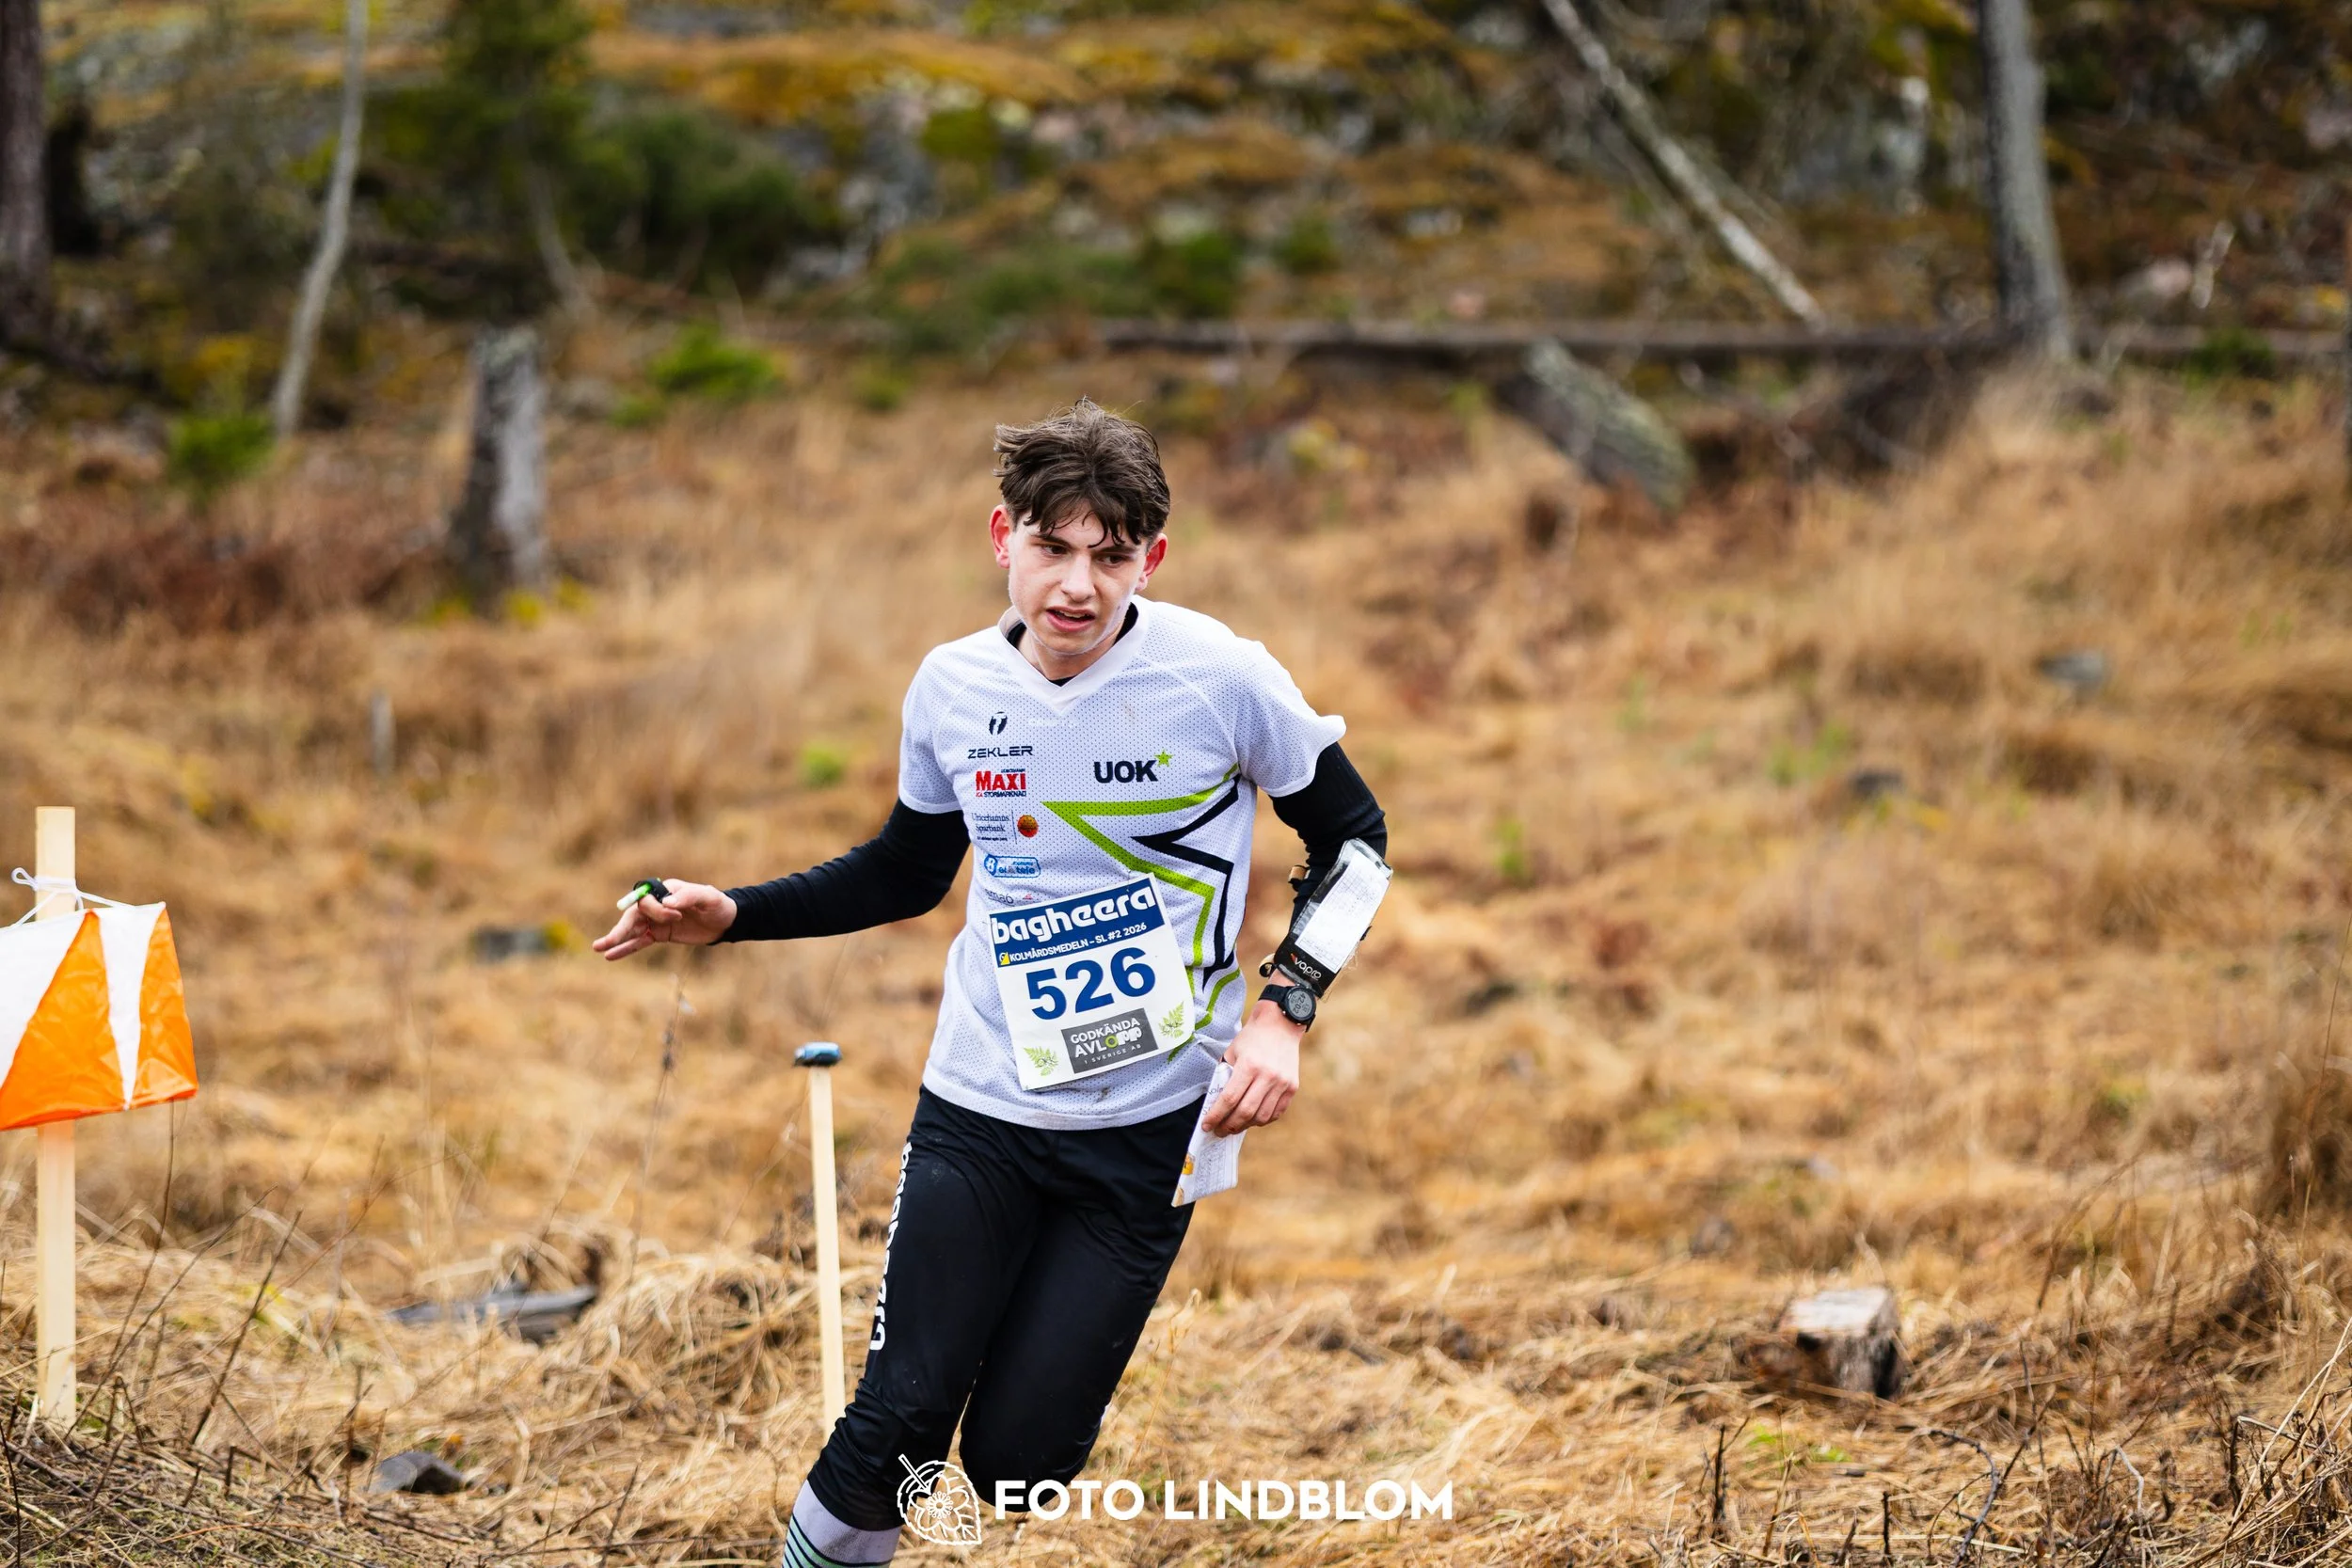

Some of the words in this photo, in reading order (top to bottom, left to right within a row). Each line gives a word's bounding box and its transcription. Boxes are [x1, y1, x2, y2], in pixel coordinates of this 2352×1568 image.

[967, 746, 1034, 759] ZEKLER
[976, 770, 1026, 791] MAXI
[1094, 760, 1158, 784] UOK
[991, 886, 1156, 944] bagheera
[1009, 939, 1089, 962] KOLMÅRDSMEDELN
[1095, 934, 1107, 944] SL
[1108, 929, 1122, 941] #2
[1122, 923, 1147, 937] 2026
[1295, 958, 1322, 979] vapro
[1026, 947, 1156, 1021] 526
[1070, 1018, 1141, 1044] GODKÄNDA
[1074, 1027, 1142, 1058] AVLOPP
[1091, 1049, 1127, 1064] SVERIGE
